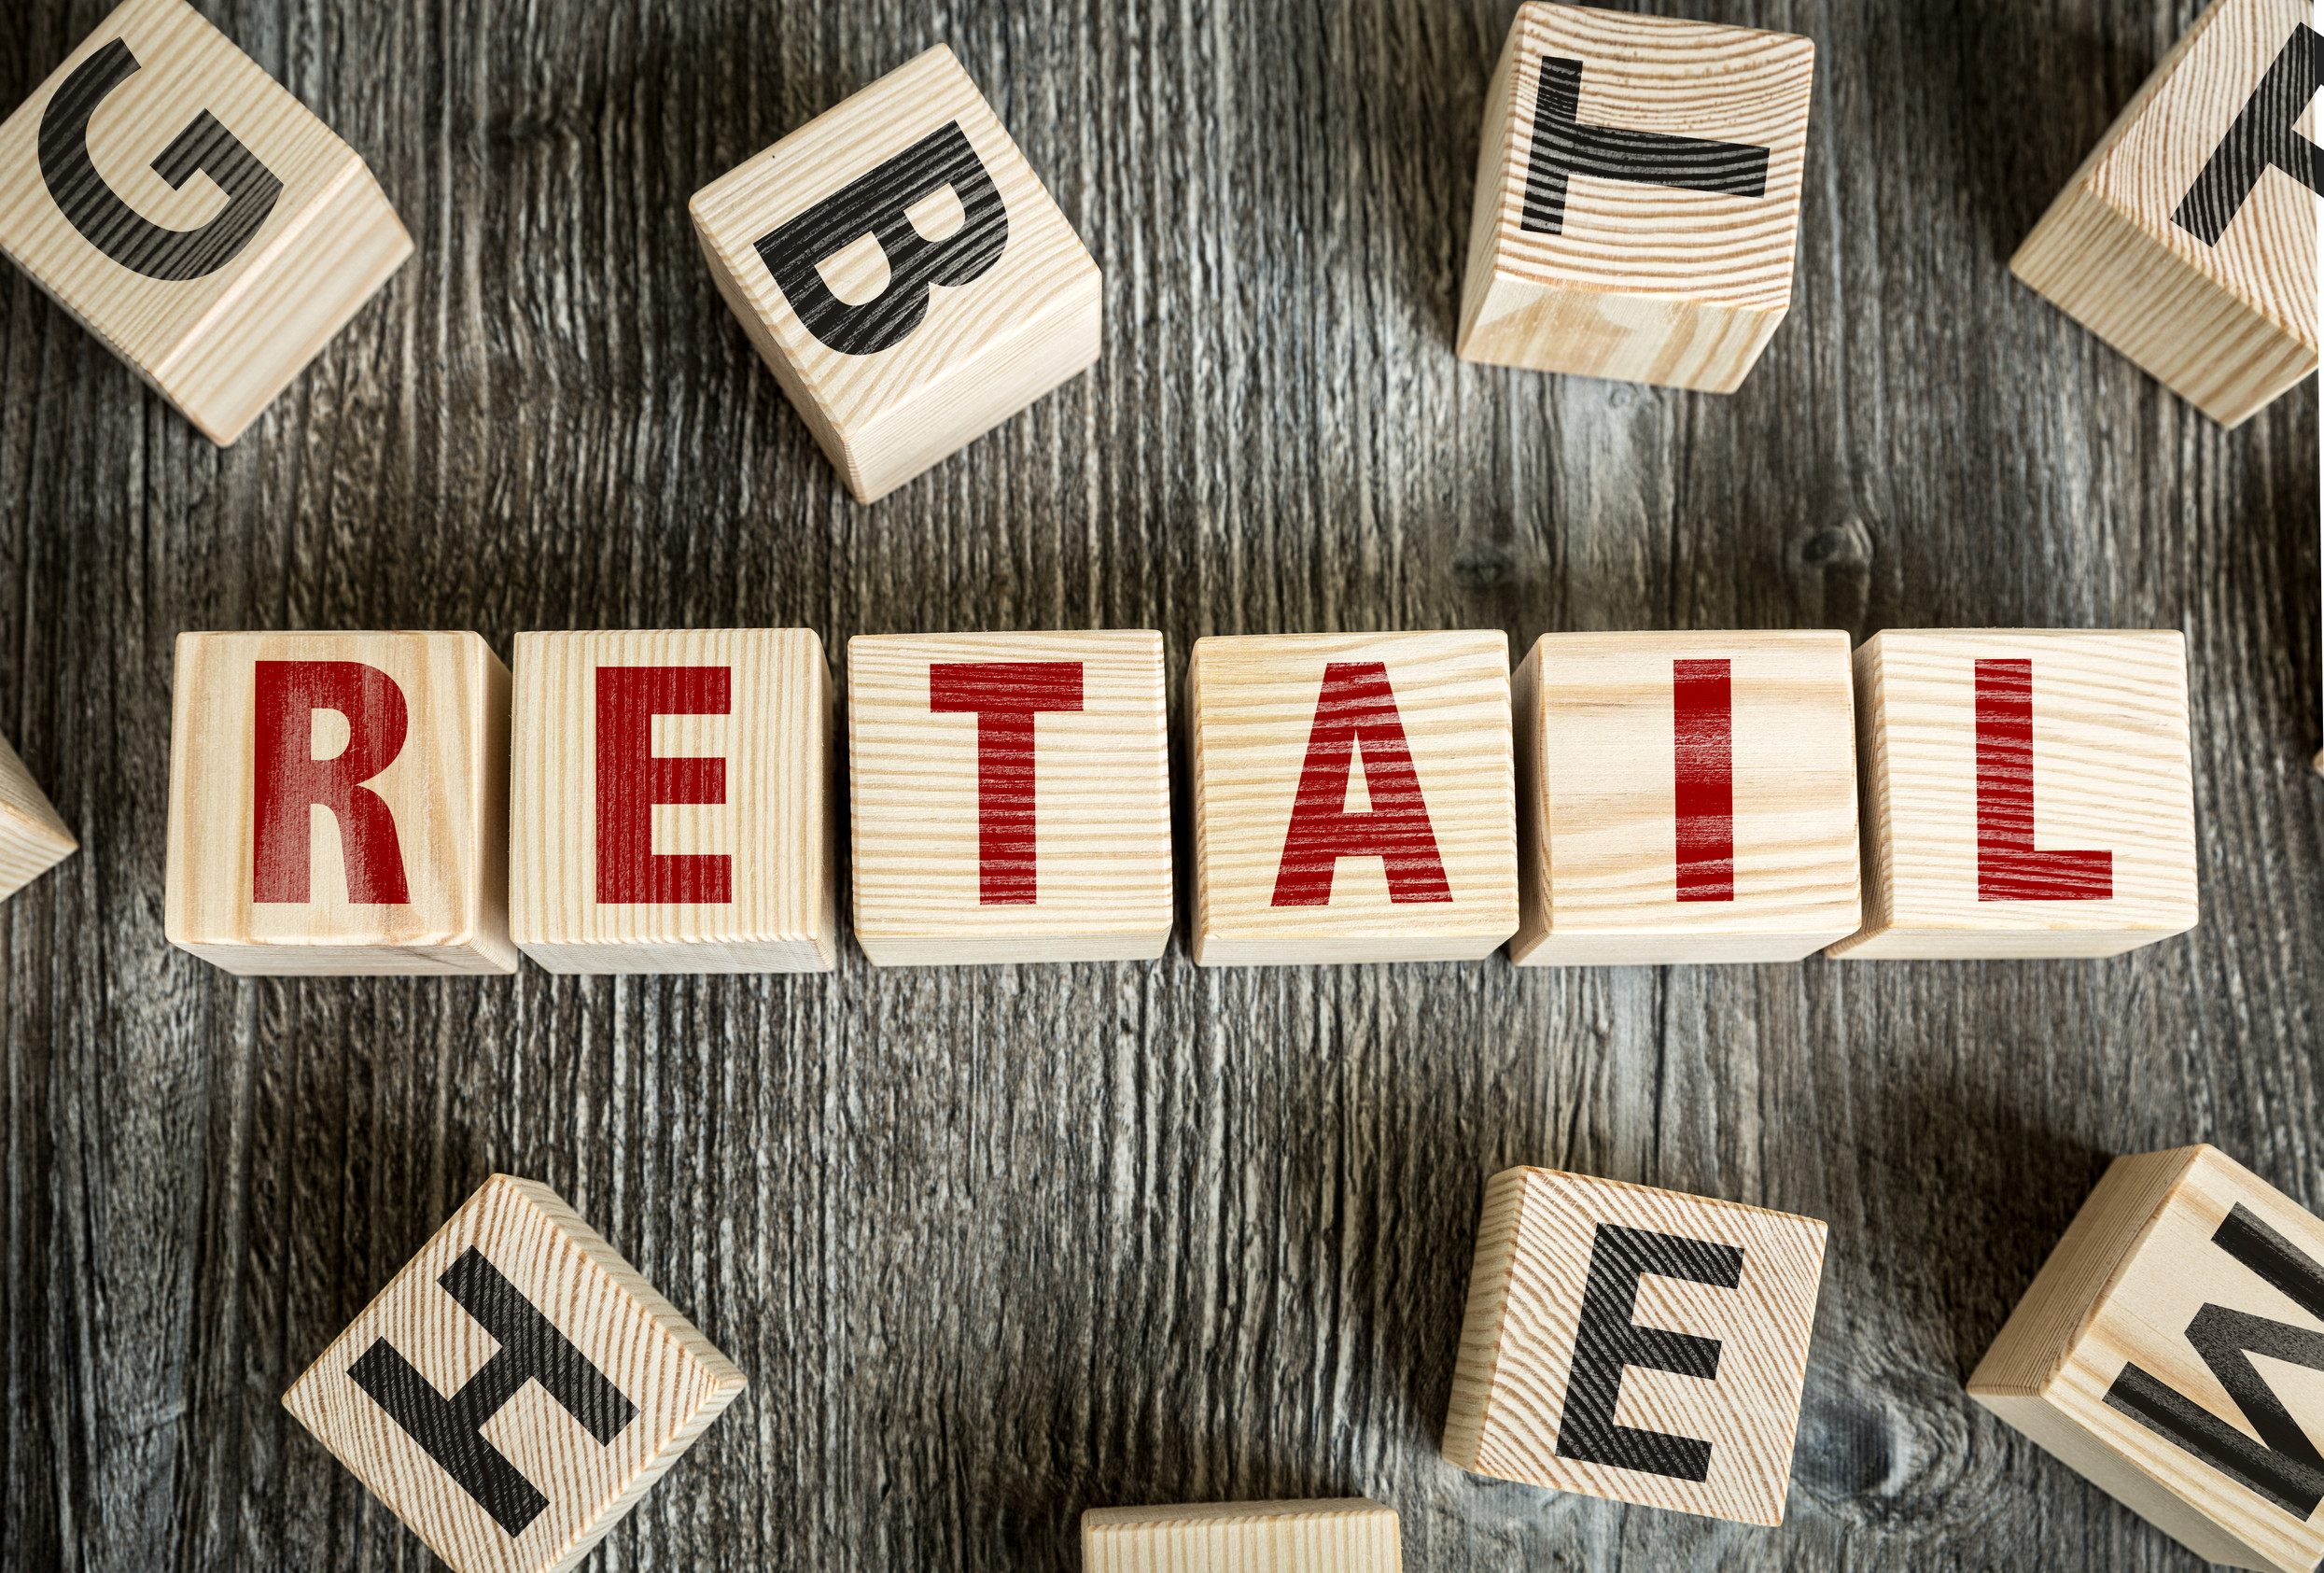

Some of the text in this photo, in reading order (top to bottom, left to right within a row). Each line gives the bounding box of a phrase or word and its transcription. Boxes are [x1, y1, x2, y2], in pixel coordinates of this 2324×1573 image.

[37, 36, 284, 282] G
[753, 120, 1009, 356] B
[1521, 56, 1770, 235] T
[254, 659, 2113, 906] RETAIL
[346, 1244, 639, 1538] H
[1556, 1223, 1743, 1482] E
